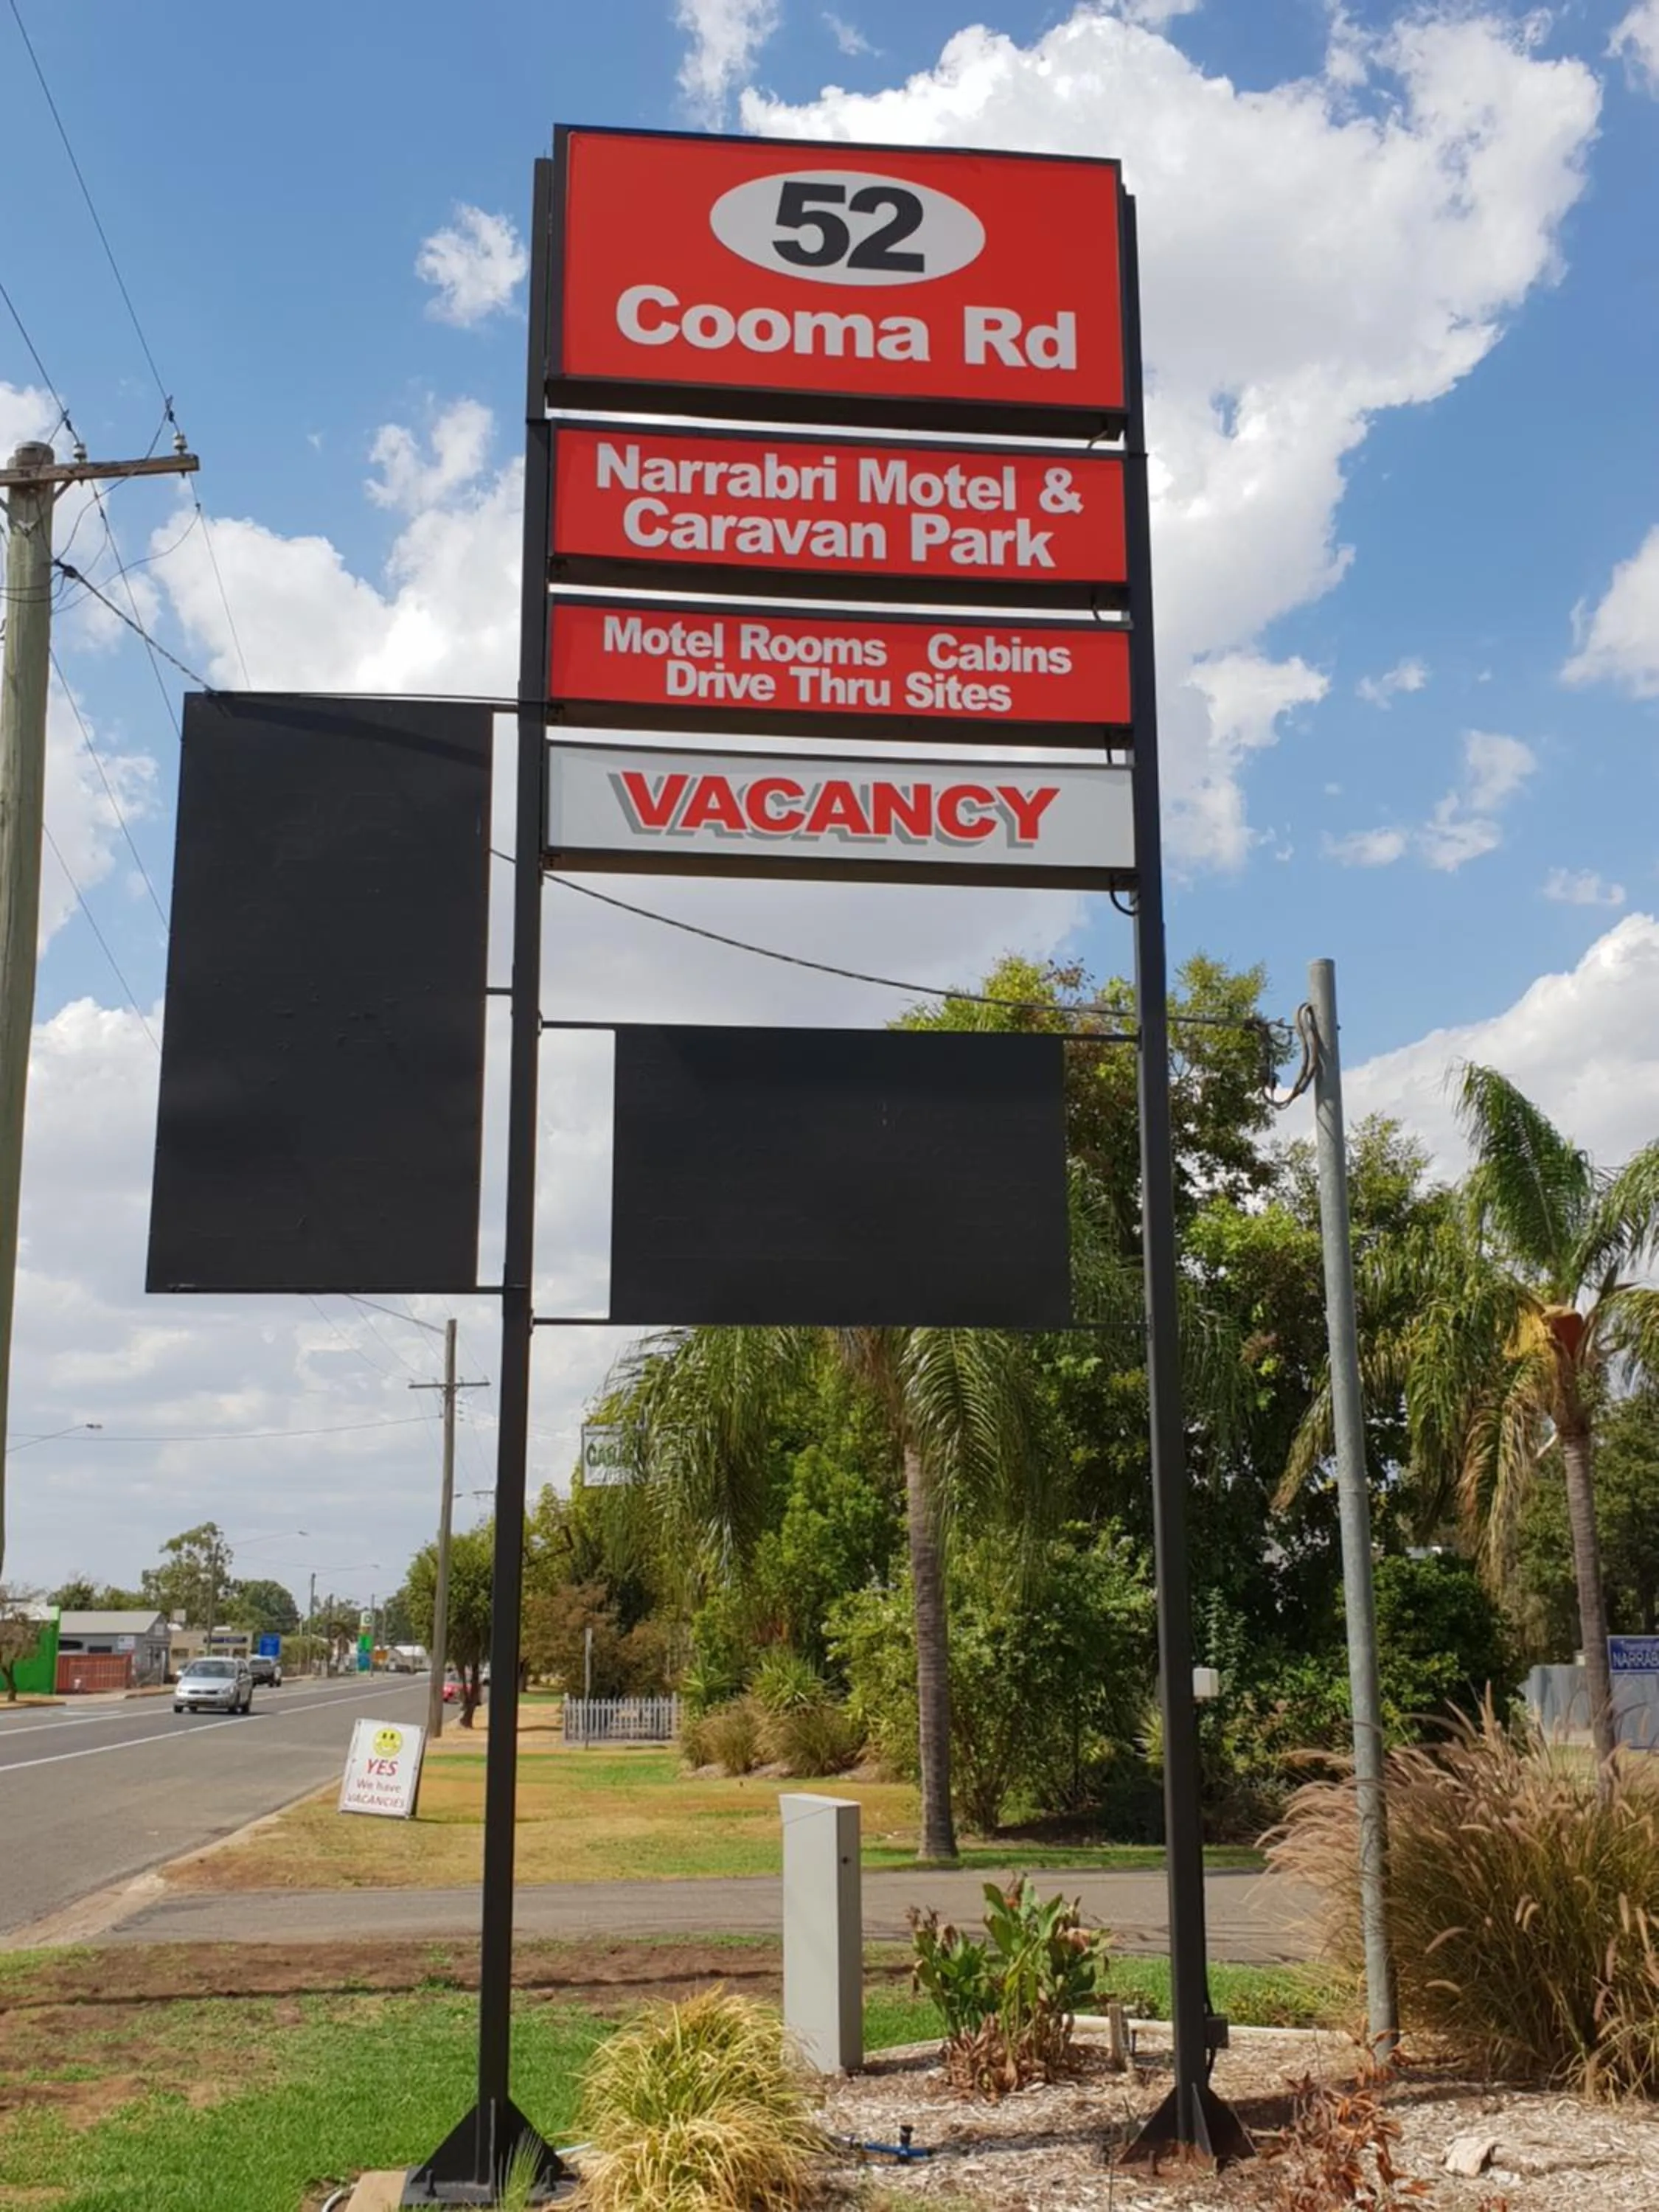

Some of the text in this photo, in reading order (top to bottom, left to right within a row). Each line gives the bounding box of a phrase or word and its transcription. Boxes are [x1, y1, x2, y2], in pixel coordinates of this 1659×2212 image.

[772, 181, 925, 274] 52
[616, 285, 1077, 369] Cooma Rd
[597, 443, 1083, 513] Narrabri Motel &
[623, 497, 1055, 567] Caravan Park
[604, 616, 887, 667] Motel Rooms
[928, 633, 1072, 674] Cabins
[666, 660, 1012, 712] Drive Thru Sites
[616, 771, 1059, 844] VACANCY
[356, 1778, 402, 1793] We have
[366, 1759, 399, 1776] YES
